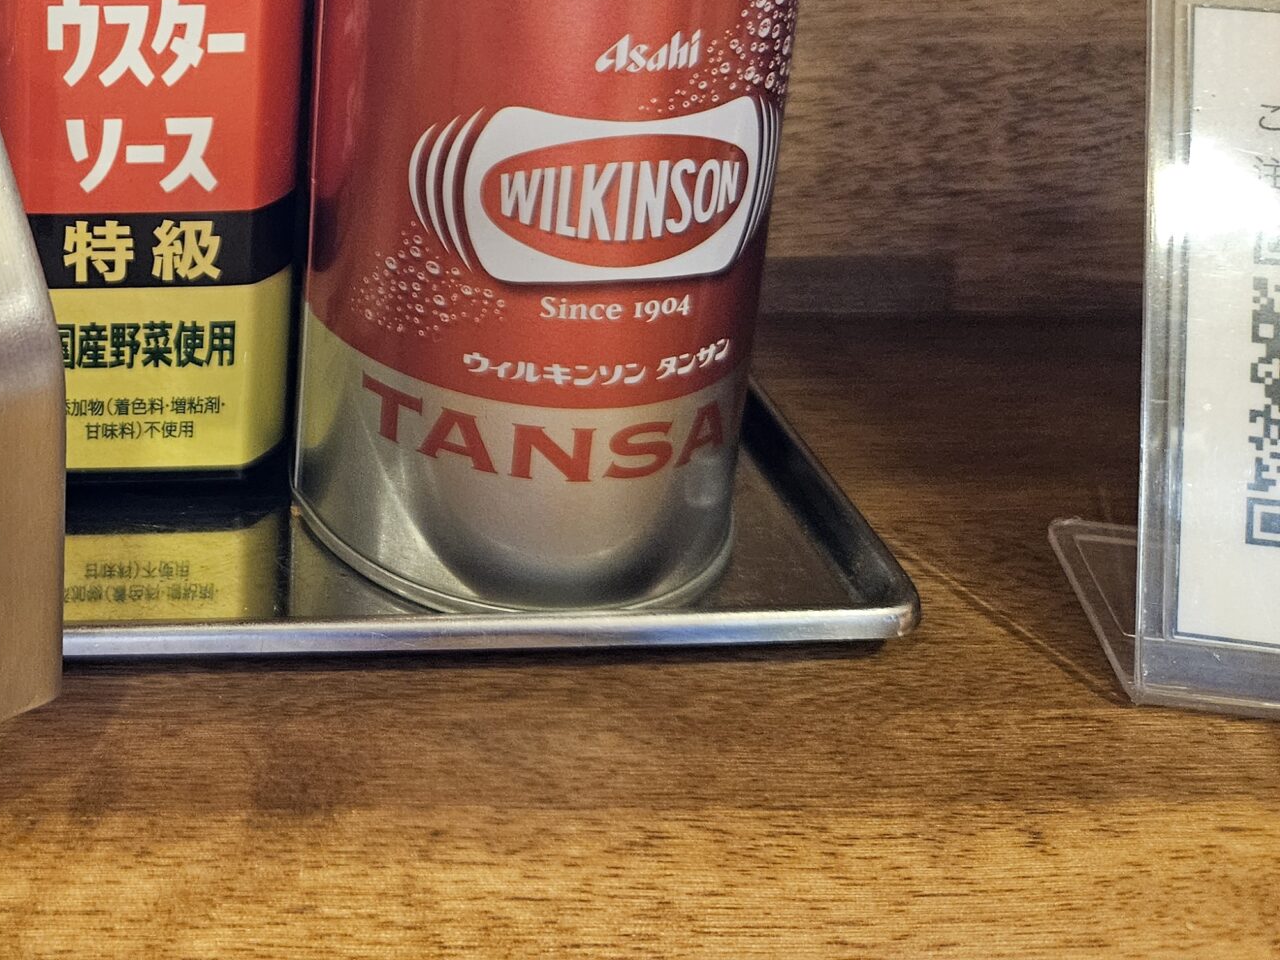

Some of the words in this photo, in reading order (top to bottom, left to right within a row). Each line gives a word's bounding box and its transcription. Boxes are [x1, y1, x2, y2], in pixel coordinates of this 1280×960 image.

[594, 28, 702, 74] Asahi
[65, 116, 218, 193] ソース
[499, 157, 741, 242] WILKINSON
[63, 219, 222, 283] 特級
[539, 296, 622, 321] Since
[633, 294, 693, 323] 1904
[462, 352, 646, 387] ウィルキンソン
[656, 338, 730, 379] タンサン
[361, 369, 742, 483] TANSA
